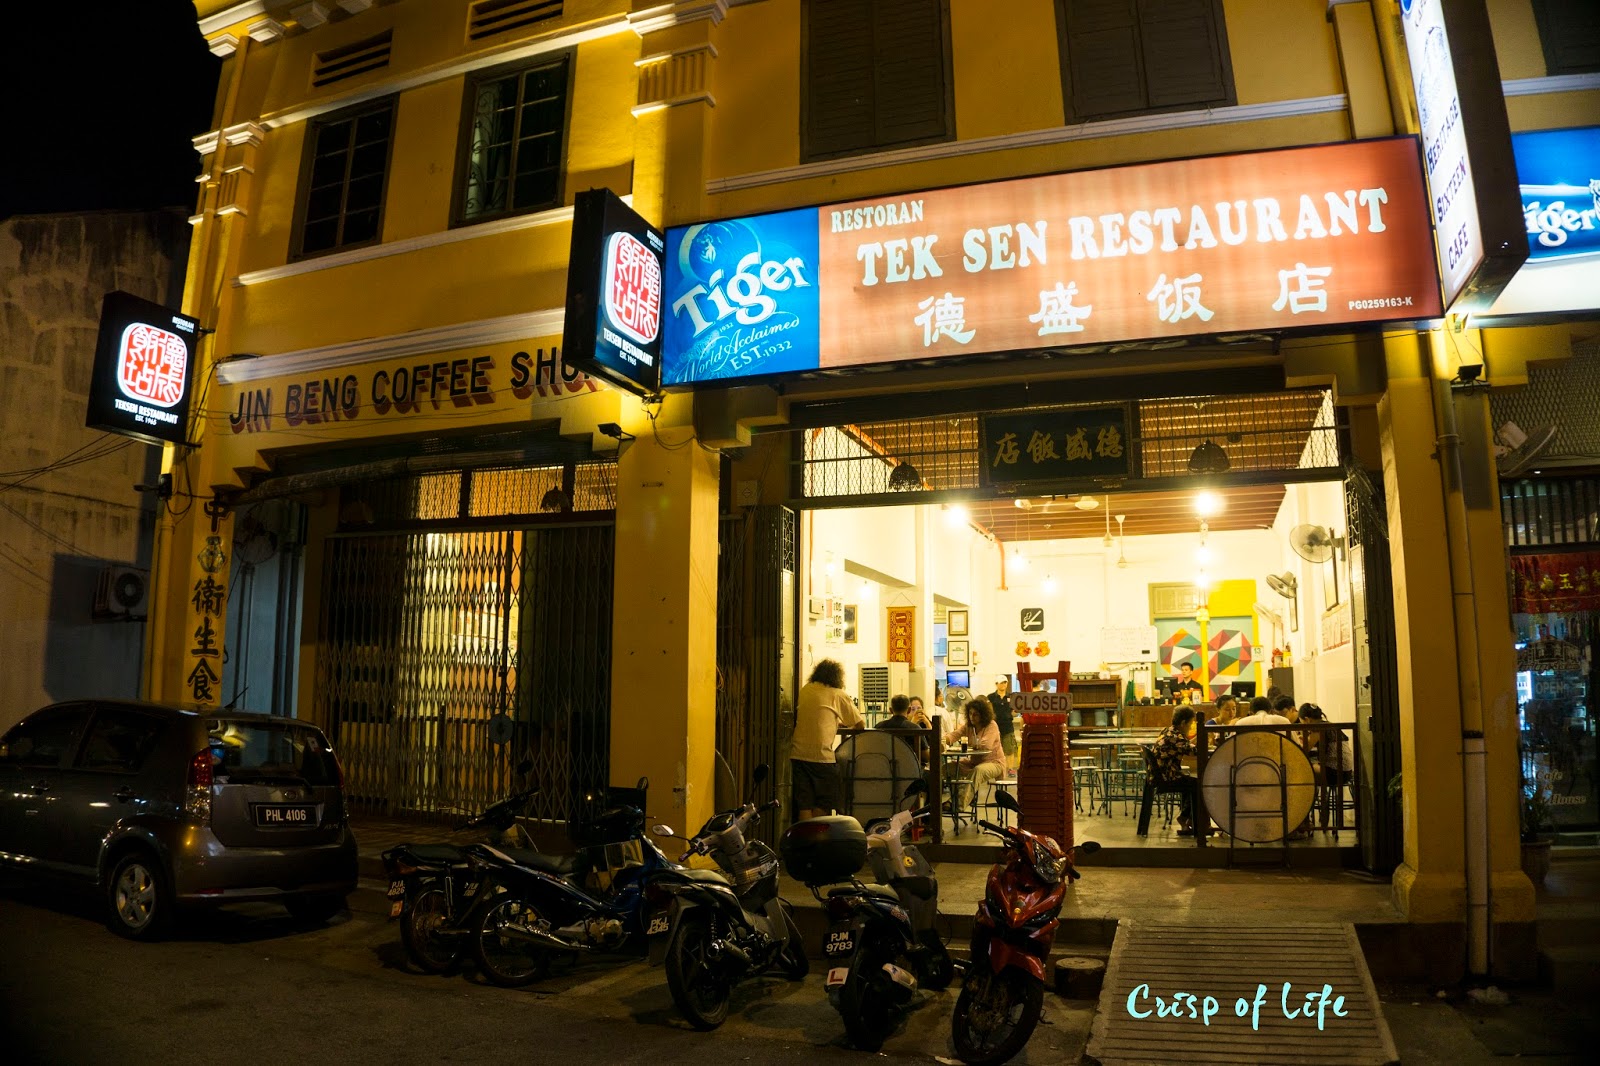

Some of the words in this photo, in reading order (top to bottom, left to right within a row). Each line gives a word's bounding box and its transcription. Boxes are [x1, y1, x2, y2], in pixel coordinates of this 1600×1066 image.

[1427, 97, 1459, 176] HERITAGE
[1437, 155, 1467, 224] SIXTEEN
[831, 200, 924, 233] RESTORAN
[1522, 201, 1596, 248] iger
[856, 234, 944, 287] TEK
[962, 219, 1048, 274] SEN
[1068, 187, 1388, 261] RESTAURANT
[1448, 223, 1469, 271] CAFE
[672, 251, 811, 339] Tiger
[914, 262, 1333, 347] 德盛饭店
[1348, 296, 1413, 311] PG0259163-K
[603, 327, 622, 349] TEKSEN
[622, 339, 653, 367] RESTAURANT
[675, 336, 724, 384] World
[722, 312, 800, 362] Acclaimed
[229, 387, 272, 428] JIN
[285, 374, 359, 422] BENG
[371, 356, 494, 409] COFFEE
[510, 346, 590, 391] SHO
[114, 399, 139, 415] TEKSEN
[138, 405, 179, 425] RESTAURANT
[1014, 695, 1068, 711] CLOSED
[1536, 682, 1563, 694] OPEN
[265, 809, 284, 821] PHL
[286, 809, 307, 821] 4106
[826, 941, 853, 953] 9783
[831, 931, 849, 942] PJM
[829, 970, 843, 983] L
